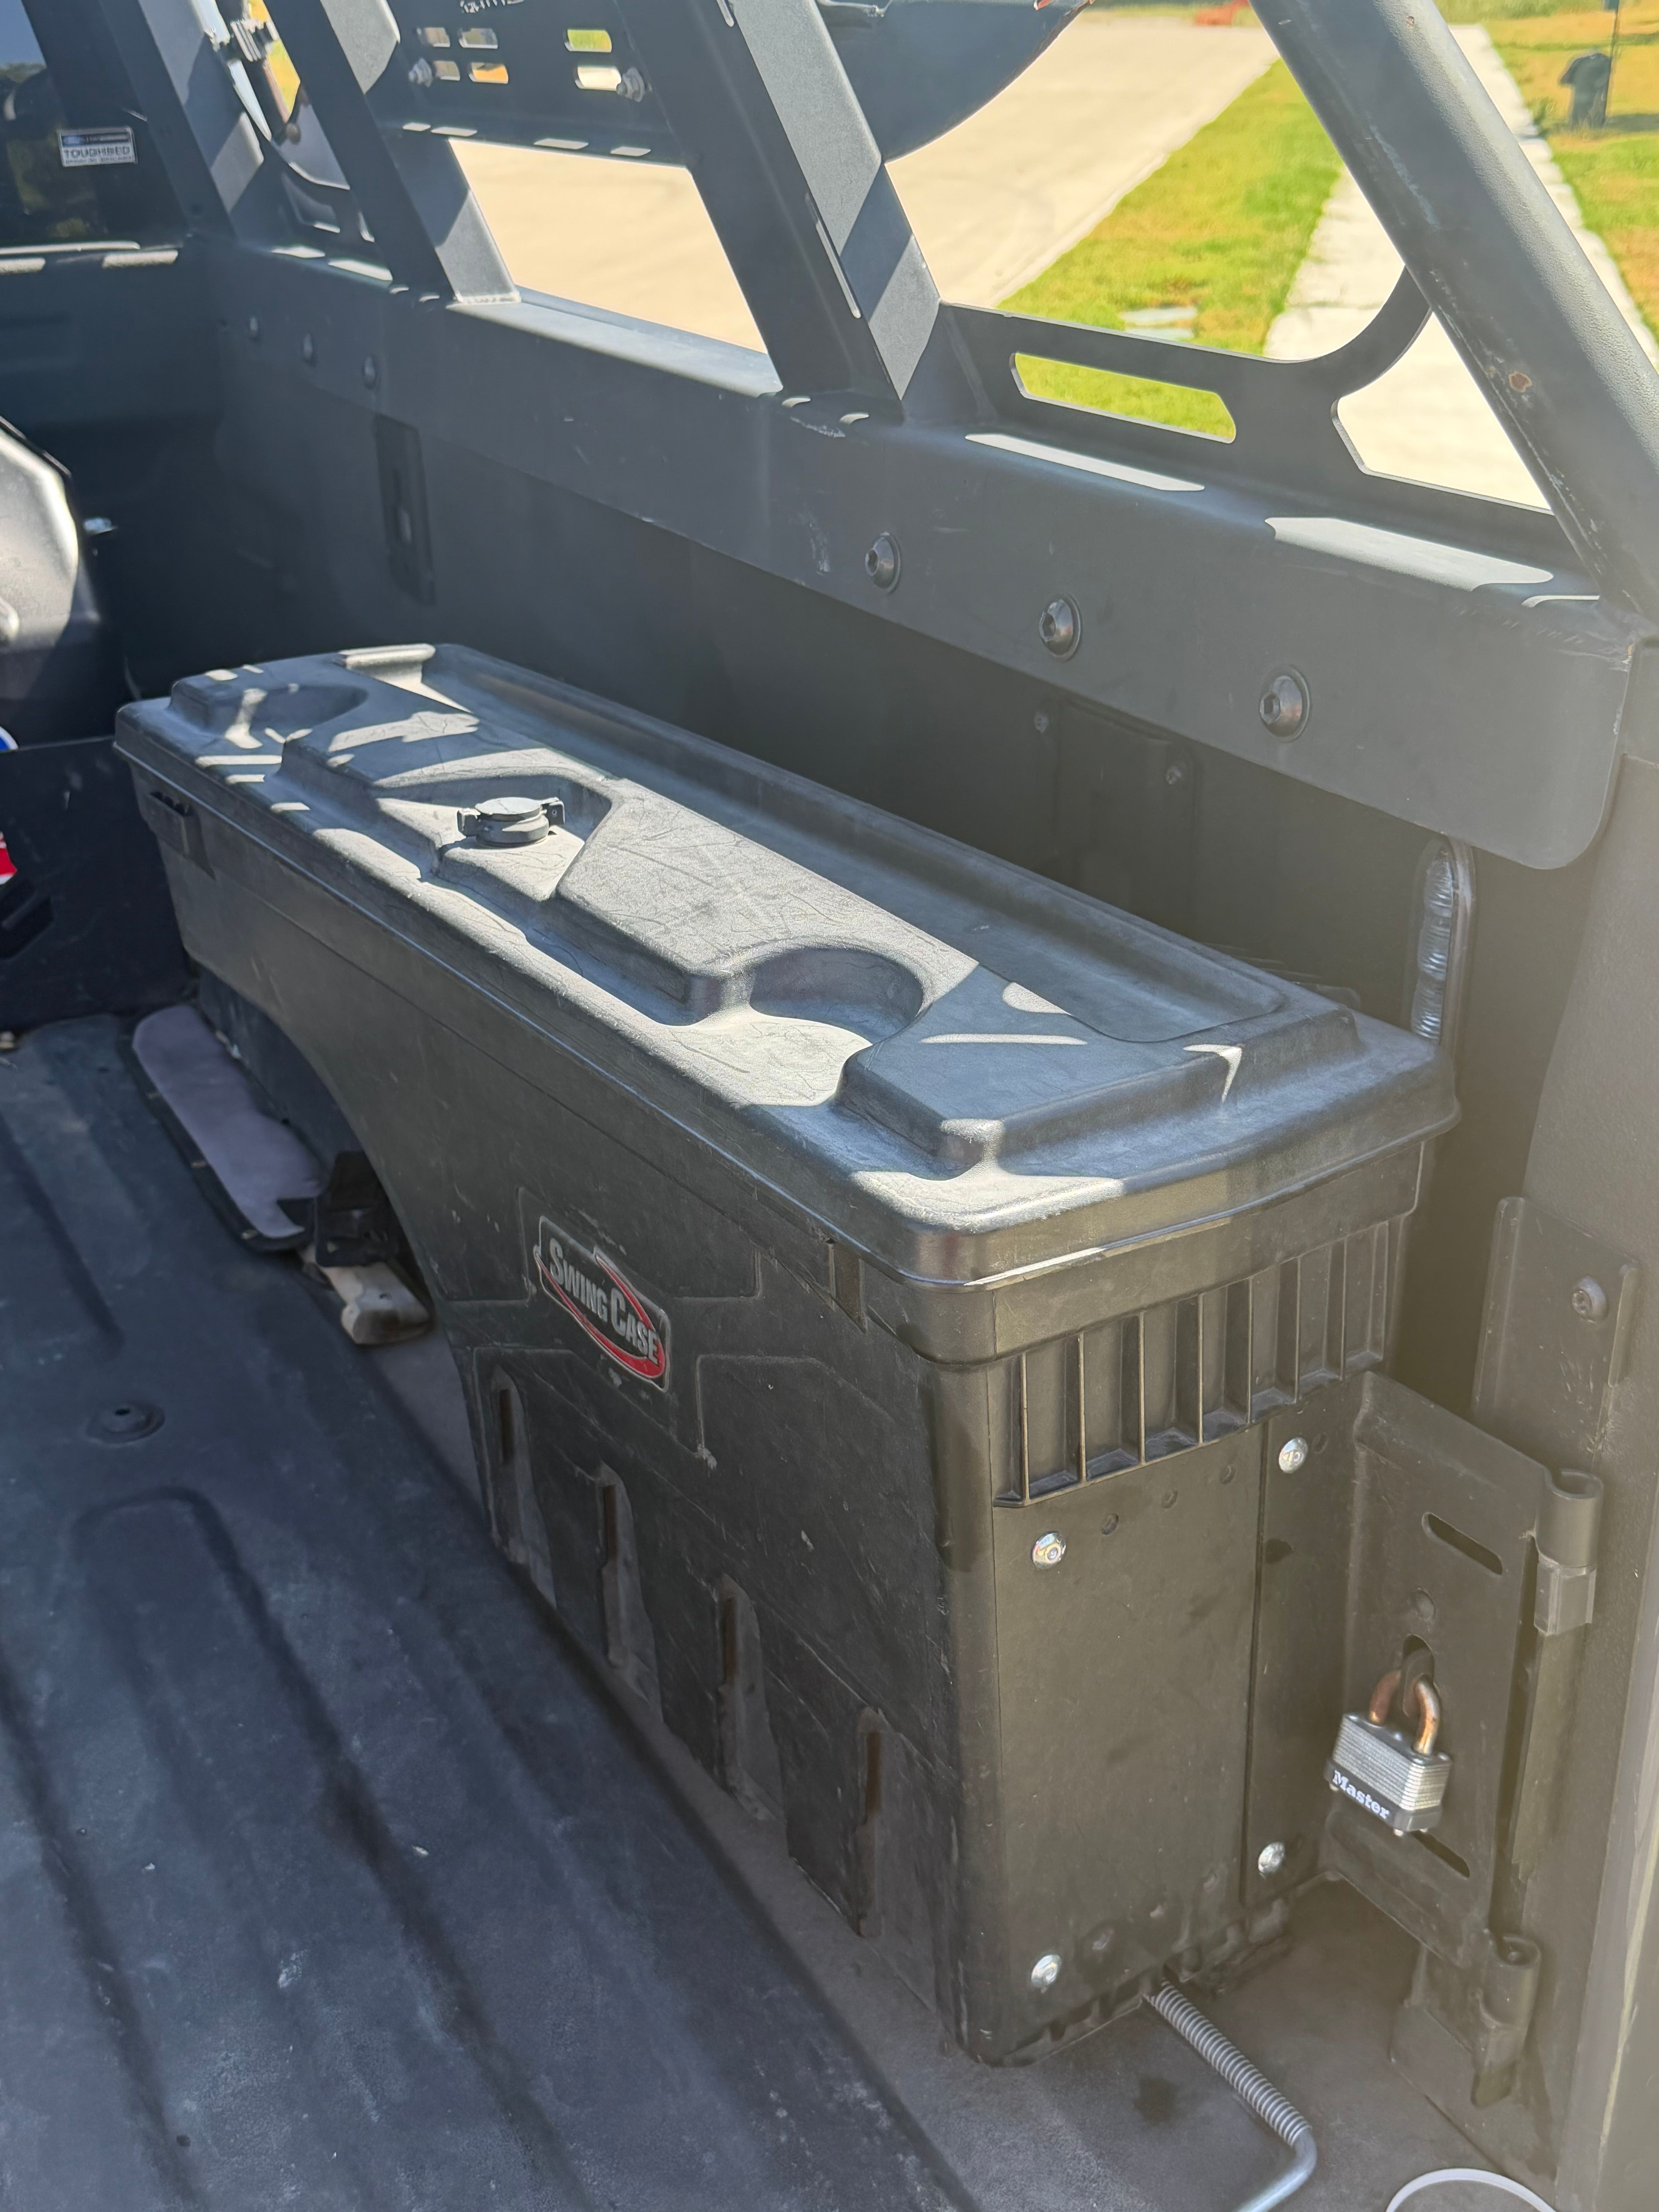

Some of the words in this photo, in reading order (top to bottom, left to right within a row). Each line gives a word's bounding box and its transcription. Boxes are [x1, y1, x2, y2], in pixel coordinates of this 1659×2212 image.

[550, 1238, 608, 1323] SWING
[611, 1288, 659, 1366] CASE
[1333, 1770, 1389, 1819] Master
